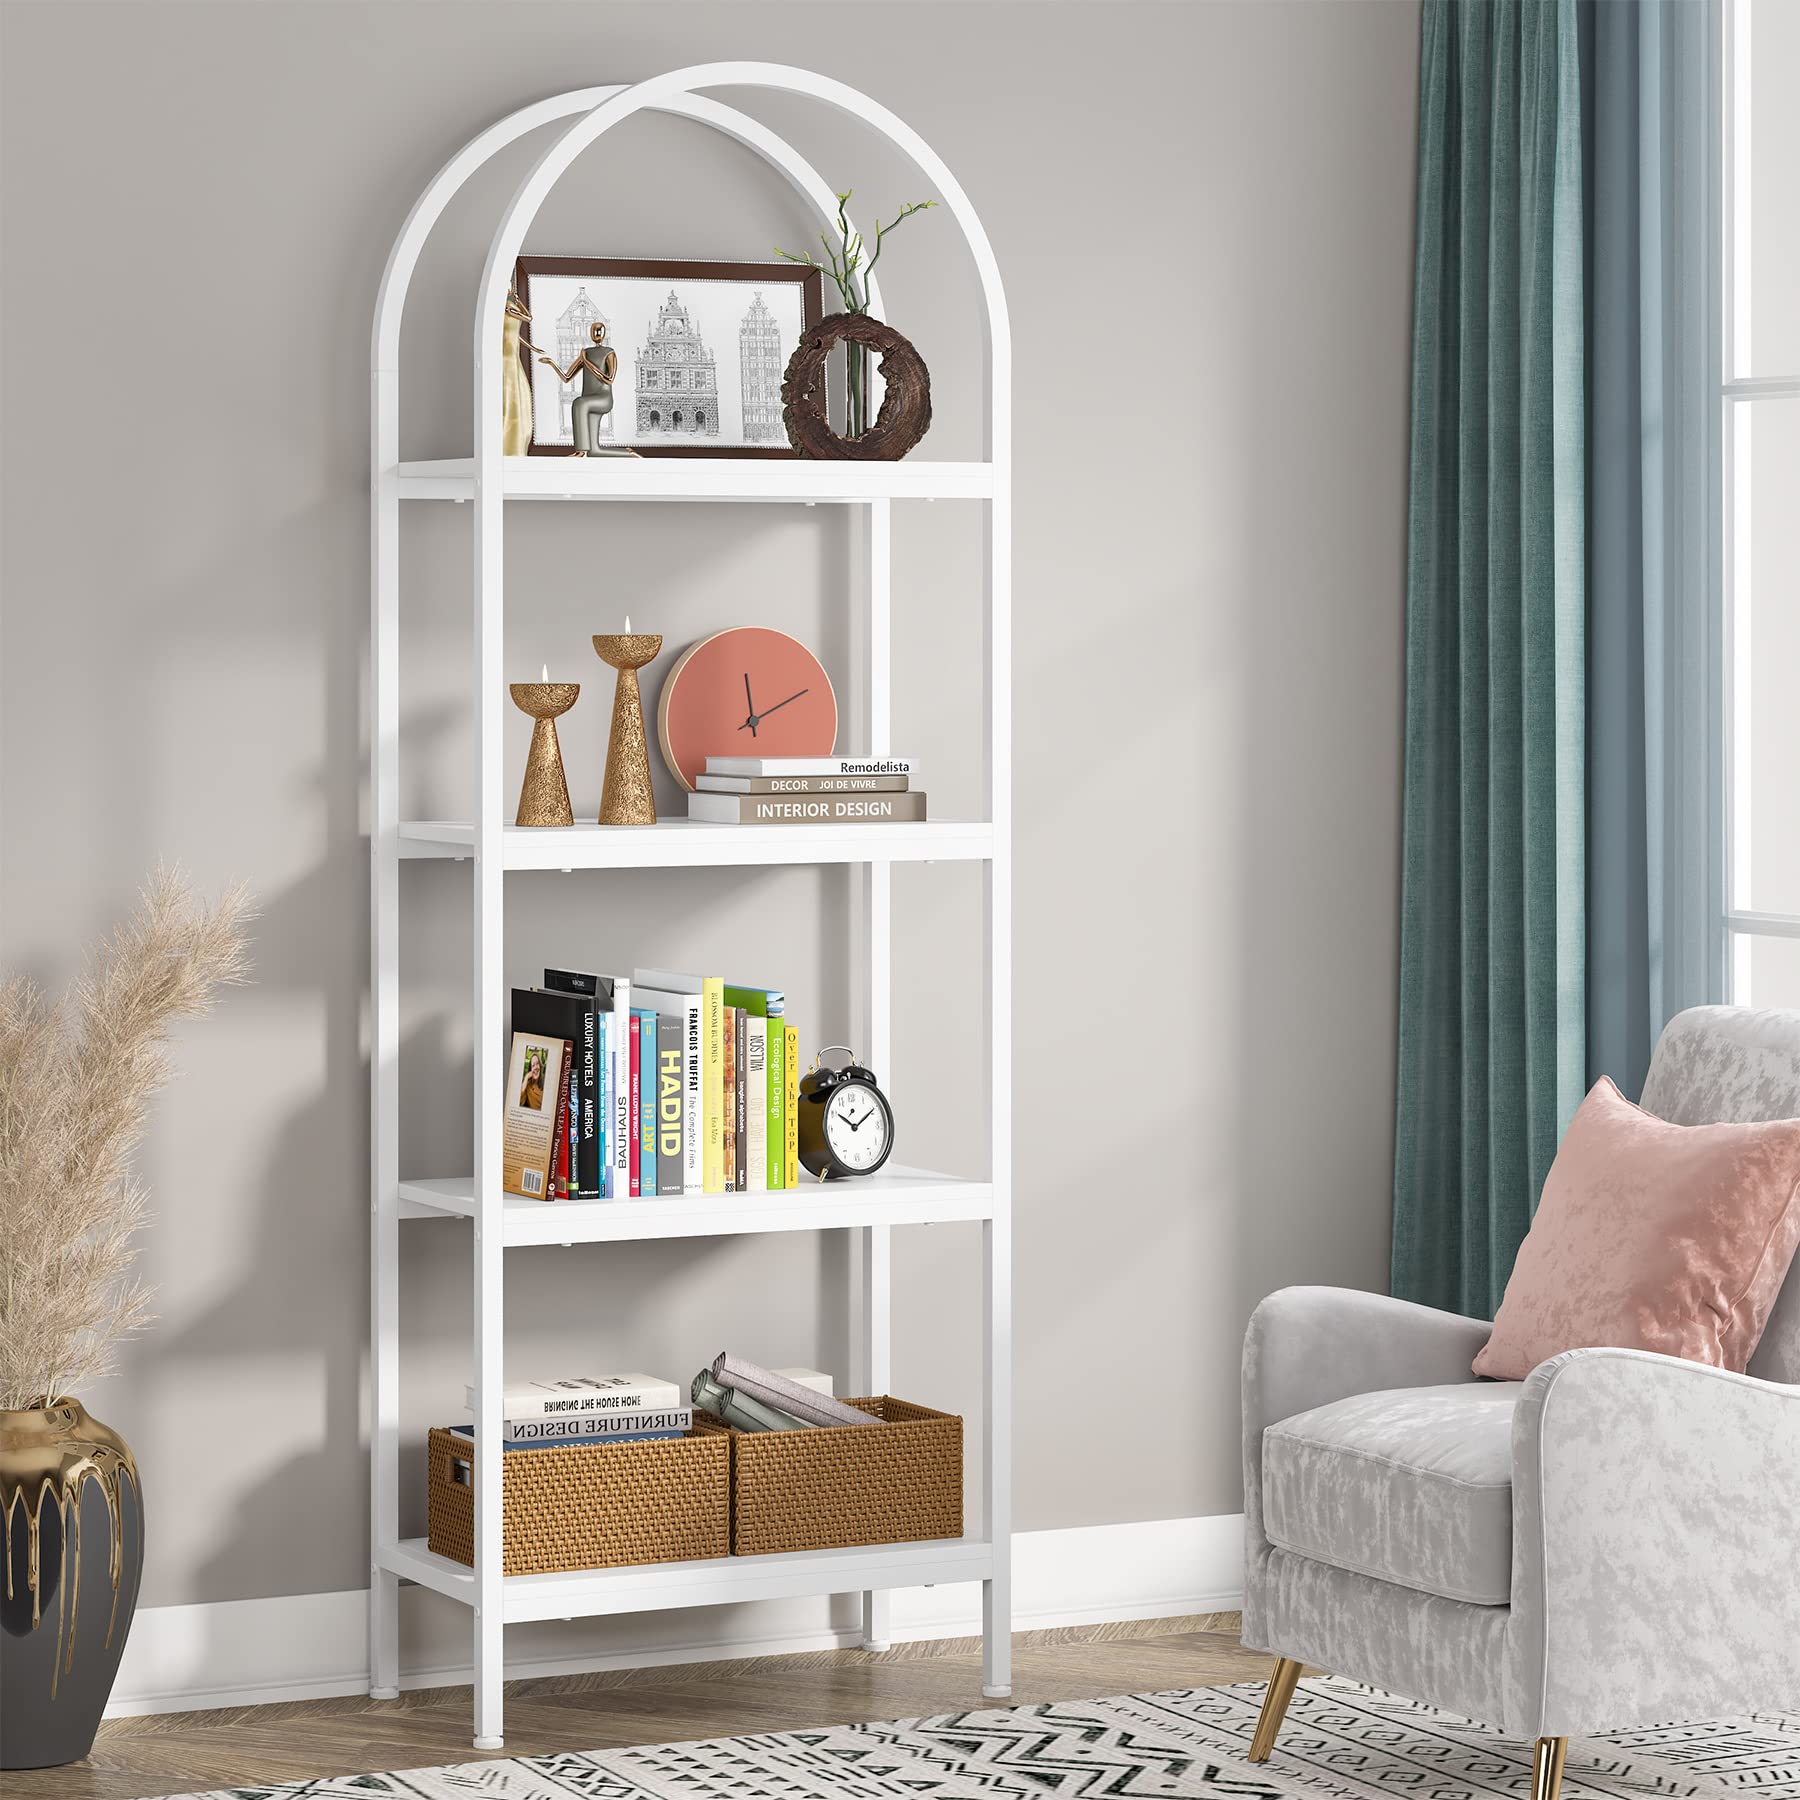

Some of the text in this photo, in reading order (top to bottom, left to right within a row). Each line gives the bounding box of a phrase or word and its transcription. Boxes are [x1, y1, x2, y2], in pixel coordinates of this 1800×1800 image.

[771, 780, 809, 791] DECOR
[819, 779, 877, 790] JOI DE VIVRE
[840, 761, 910, 774] Remodelista
[756, 801, 892, 818] INTERIOR DESIGN
[689, 1008, 698, 1051] FRANCOIS
[750, 1034, 765, 1072] WILLSON
[788, 1033, 796, 1070] Over
[584, 1012, 593, 1139] LUXURY HOTELS AMERICA
[689, 1054, 698, 1091] TRUFFAT
[771, 1037, 782, 1119] Ecological Design
[660, 1050, 681, 1157] HADID
[689, 1096, 697, 1110] The
[618, 1096, 627, 1169] BAUHAUS
[642, 1123, 655, 1153] ART
